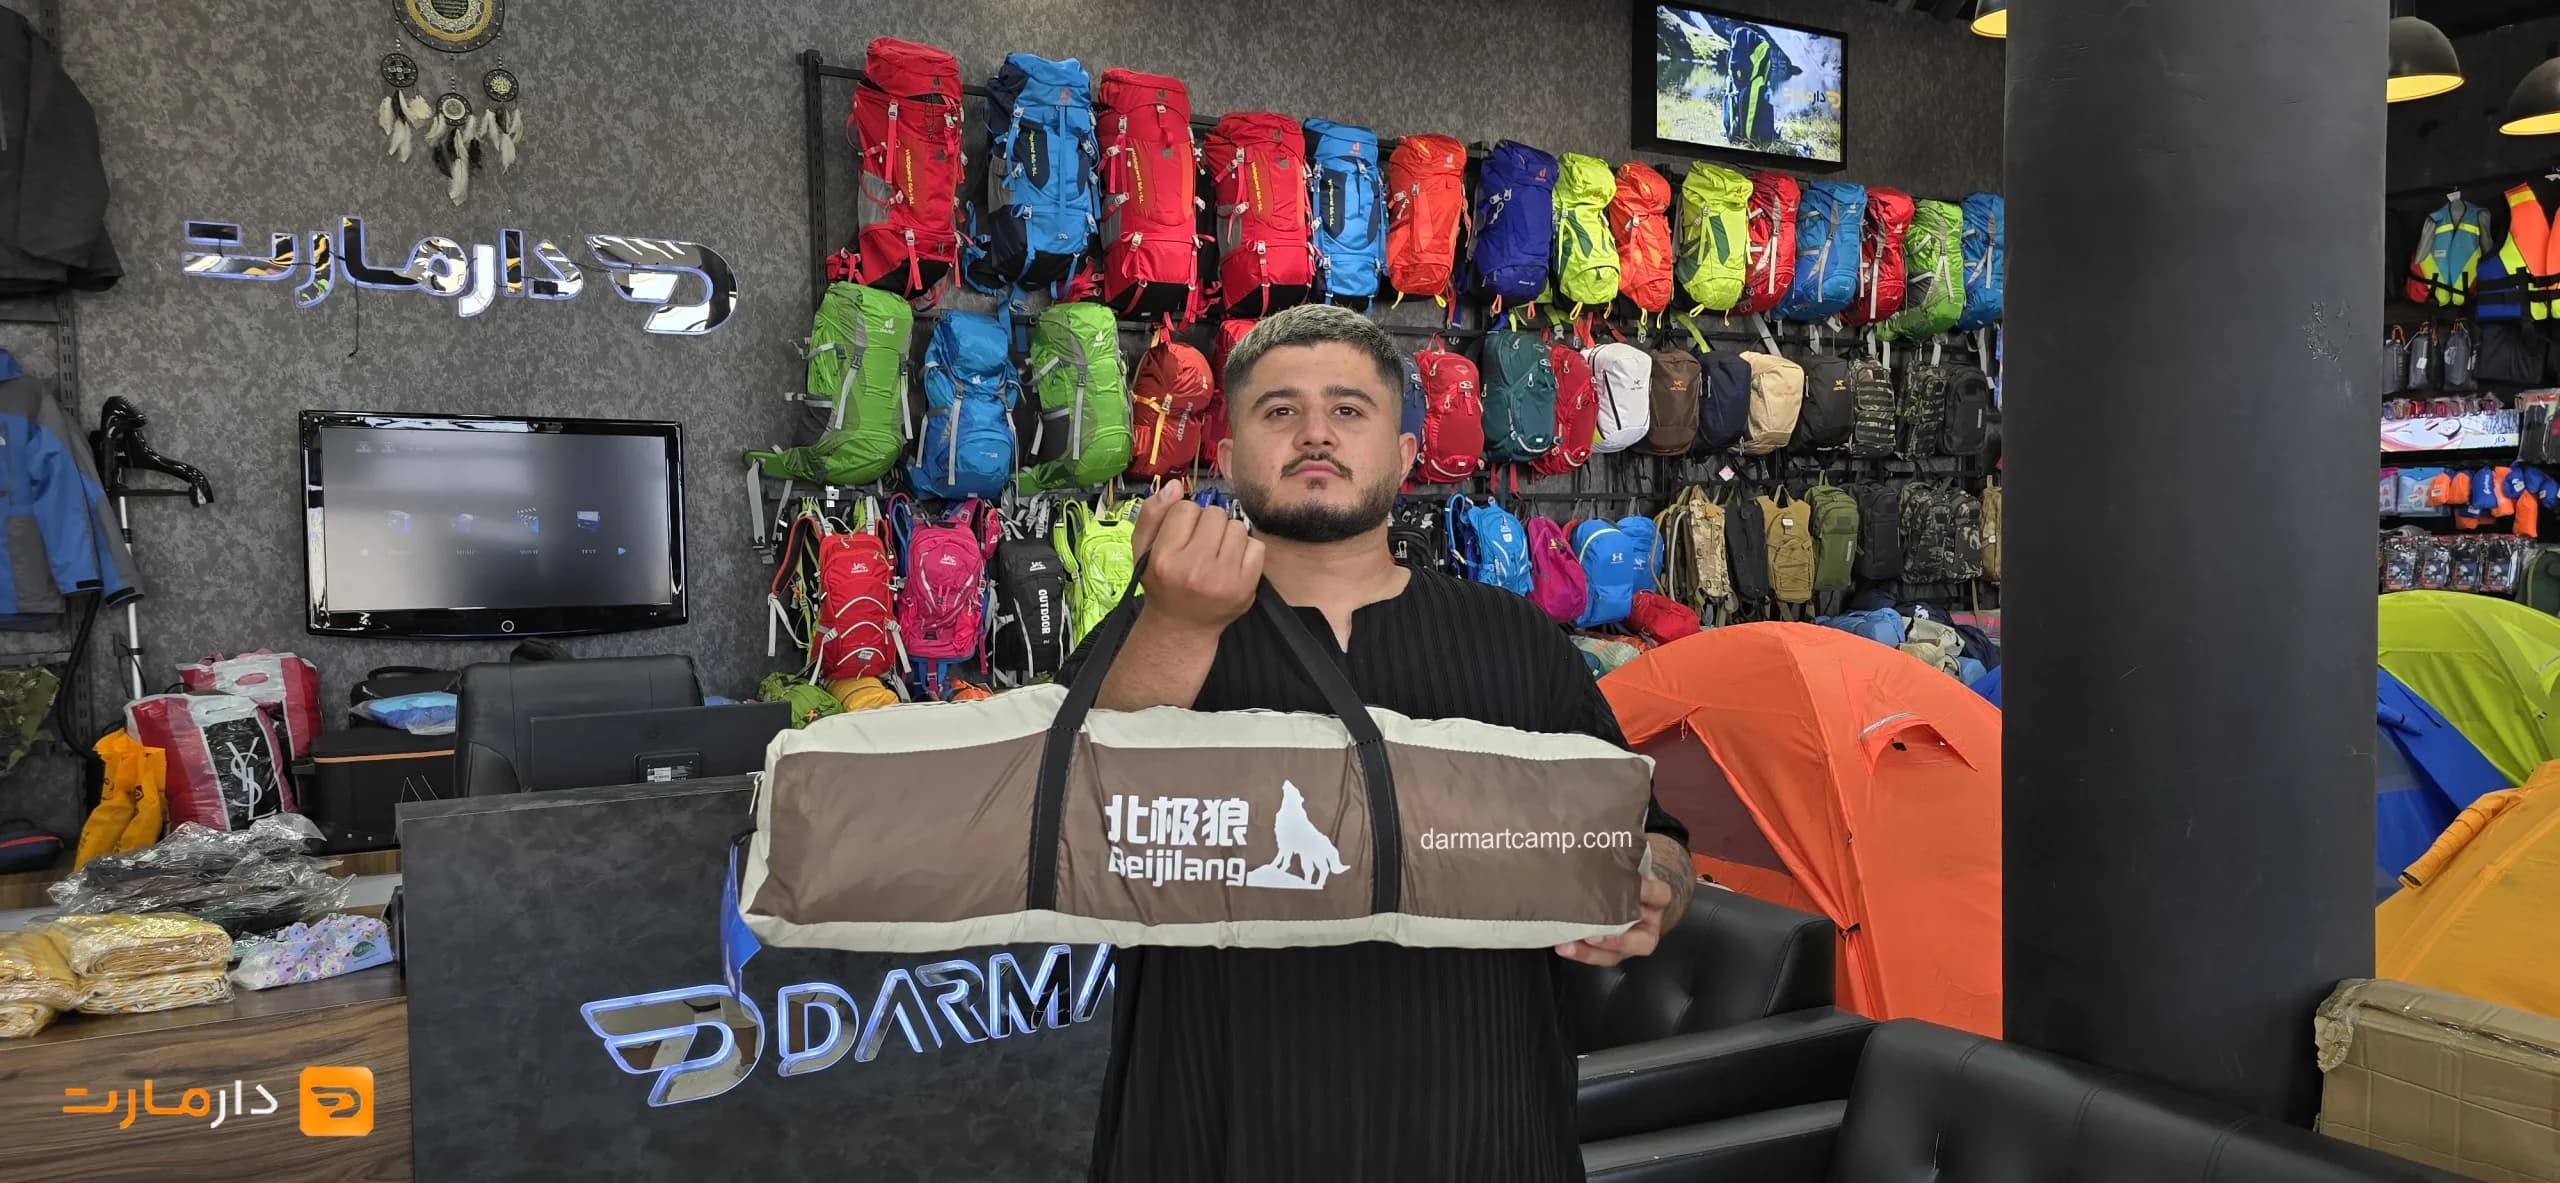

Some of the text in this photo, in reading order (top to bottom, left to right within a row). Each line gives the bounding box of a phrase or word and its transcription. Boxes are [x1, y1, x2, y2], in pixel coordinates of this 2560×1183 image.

[182, 215, 583, 318] دارمارت
[1038, 588, 1050, 635] OUTDOOR
[1104, 794, 1250, 846] 北极狼
[1420, 827, 1633, 854] darmartcamp.com
[1108, 846, 1247, 888] Beijilang
